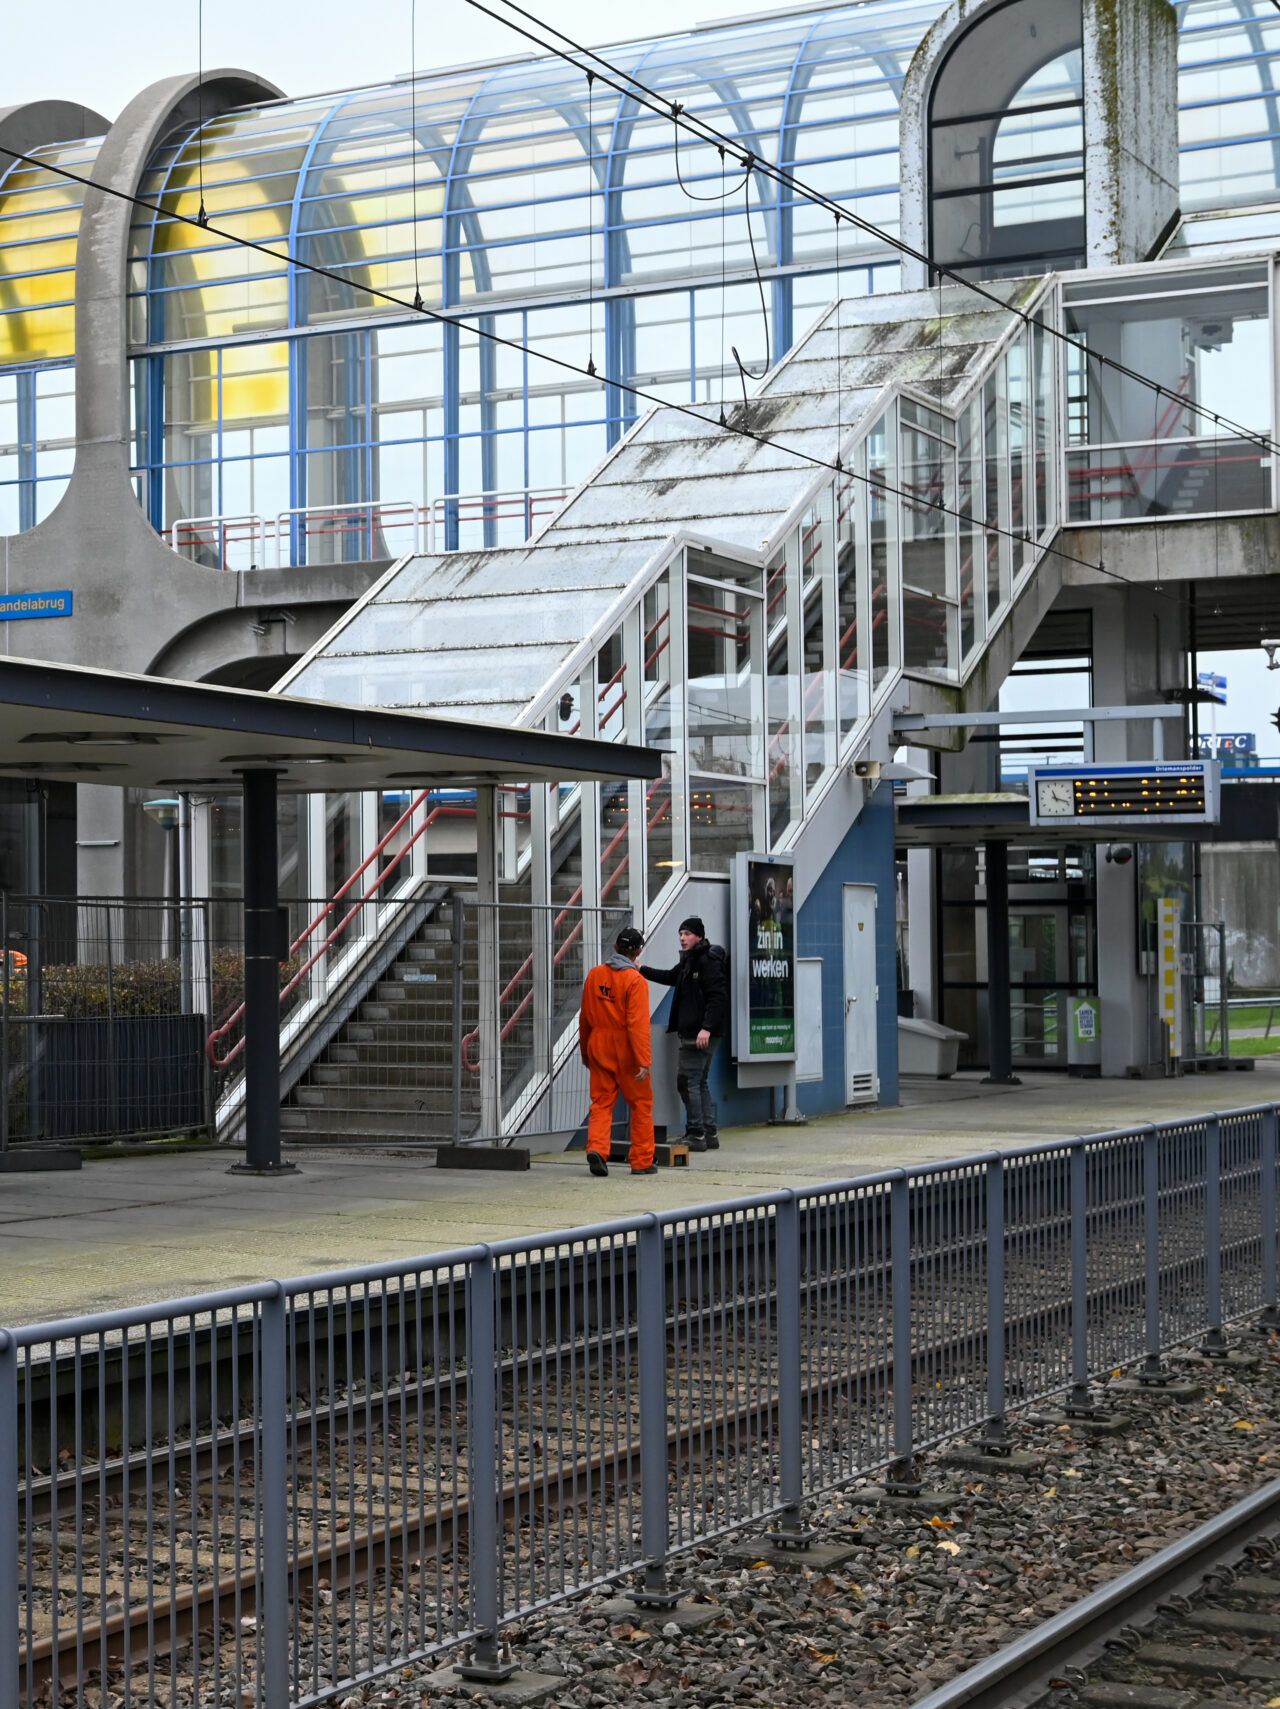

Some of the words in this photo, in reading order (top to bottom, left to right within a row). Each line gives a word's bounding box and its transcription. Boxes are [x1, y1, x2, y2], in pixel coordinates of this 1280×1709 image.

[756, 927, 771, 949] zin
[773, 926, 783, 949] in
[752, 957, 789, 978] werken
